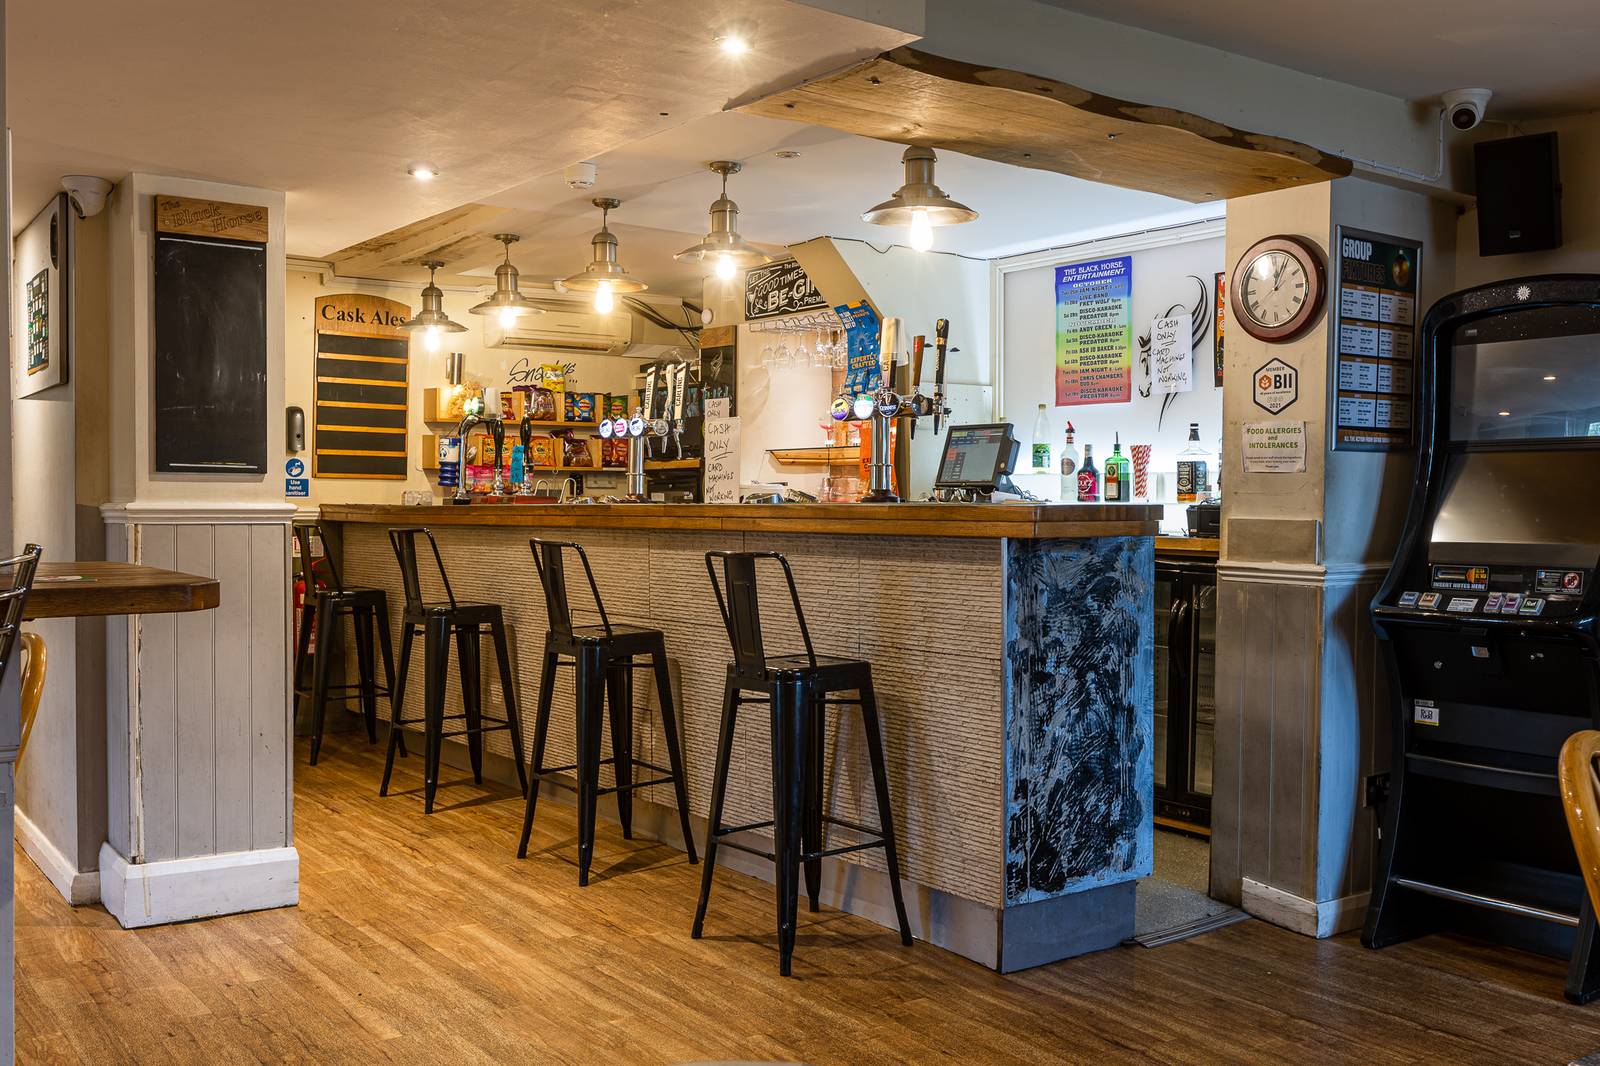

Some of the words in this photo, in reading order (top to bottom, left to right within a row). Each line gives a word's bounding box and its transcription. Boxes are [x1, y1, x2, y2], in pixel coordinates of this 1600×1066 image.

[173, 202, 222, 227] Black
[212, 210, 263, 232] Horse
[1343, 238, 1372, 260] GROUP
[1078, 264, 1099, 273] BLACK
[1101, 261, 1123, 270] HORSE
[1062, 267, 1126, 283] ENTERTAINMENT
[758, 278, 780, 297] GOOD
[780, 268, 804, 286] TIMES
[1073, 278, 1112, 288] OCTOBER
[322, 304, 365, 324] Cask
[370, 309, 406, 327] Ales
[1080, 312, 1108, 320] PREDATOR
[1157, 320, 1179, 329] CASH
[1080, 331, 1123, 340] DISCO-KARAOKE
[1157, 330, 1177, 341] ONLY
[1152, 347, 1171, 356] CARD
[1157, 363, 1173, 374] NOT
[1273, 373, 1292, 390] BII
[645, 381, 653, 410] CARLING
[675, 377, 683, 407] CARLING
[708, 422, 731, 435] CASH
[708, 438, 730, 451] ONLY
[1248, 441, 1299, 449] INTOLERANCES
[708, 462, 723, 472] CARD
